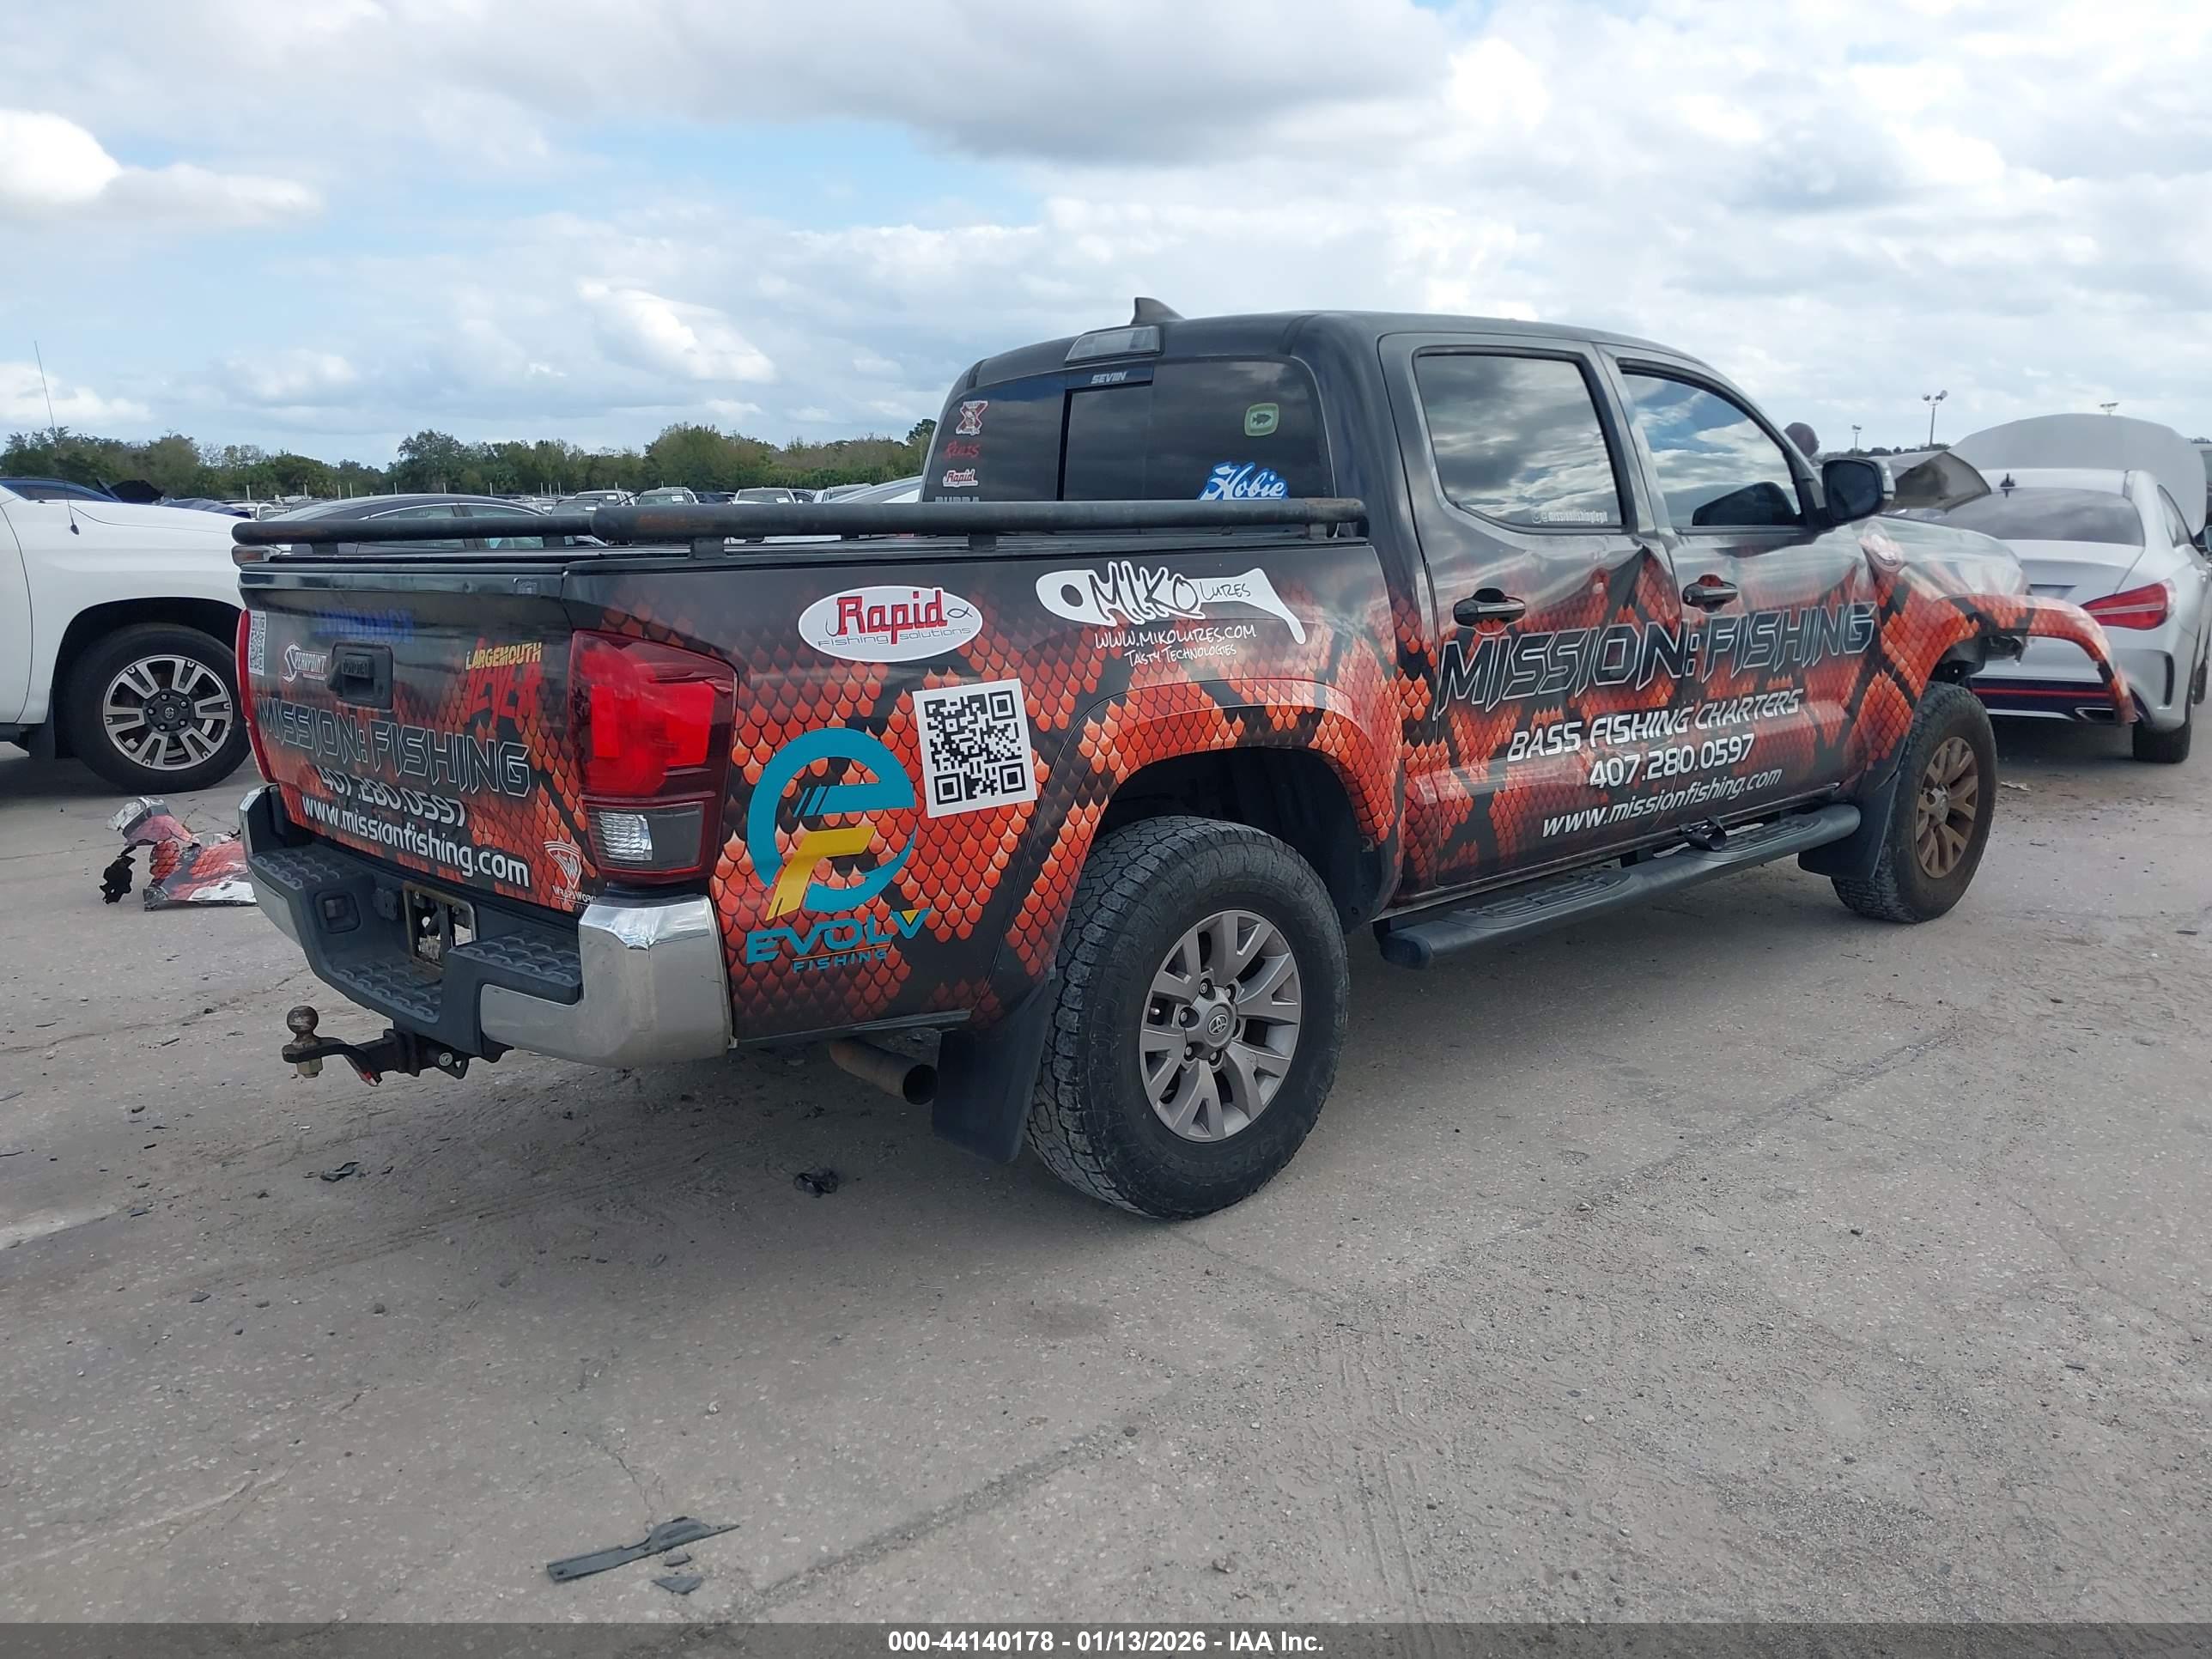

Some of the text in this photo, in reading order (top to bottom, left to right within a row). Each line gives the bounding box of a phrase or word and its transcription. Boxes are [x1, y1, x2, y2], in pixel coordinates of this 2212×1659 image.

[1200, 465, 1285, 500] Hobie
[836, 589, 948, 645] Rapid
[1087, 562, 1206, 623] MIKO
[899, 626, 971, 641] solutions
[1701, 602, 1876, 684] FISHING
[1507, 688, 1804, 763] BASS FISHING CHARTERS
[368, 719, 531, 798] FISHING
[1589, 733, 1757, 789] 407.280.0597
[319, 765, 467, 828] 407.280.0597
[1542, 769, 1783, 838] www.missionfishing.com
[302, 796, 531, 888] www.missionfishing.com
[746, 908, 932, 963] EVOLV
[793, 948, 889, 974] FISHING
